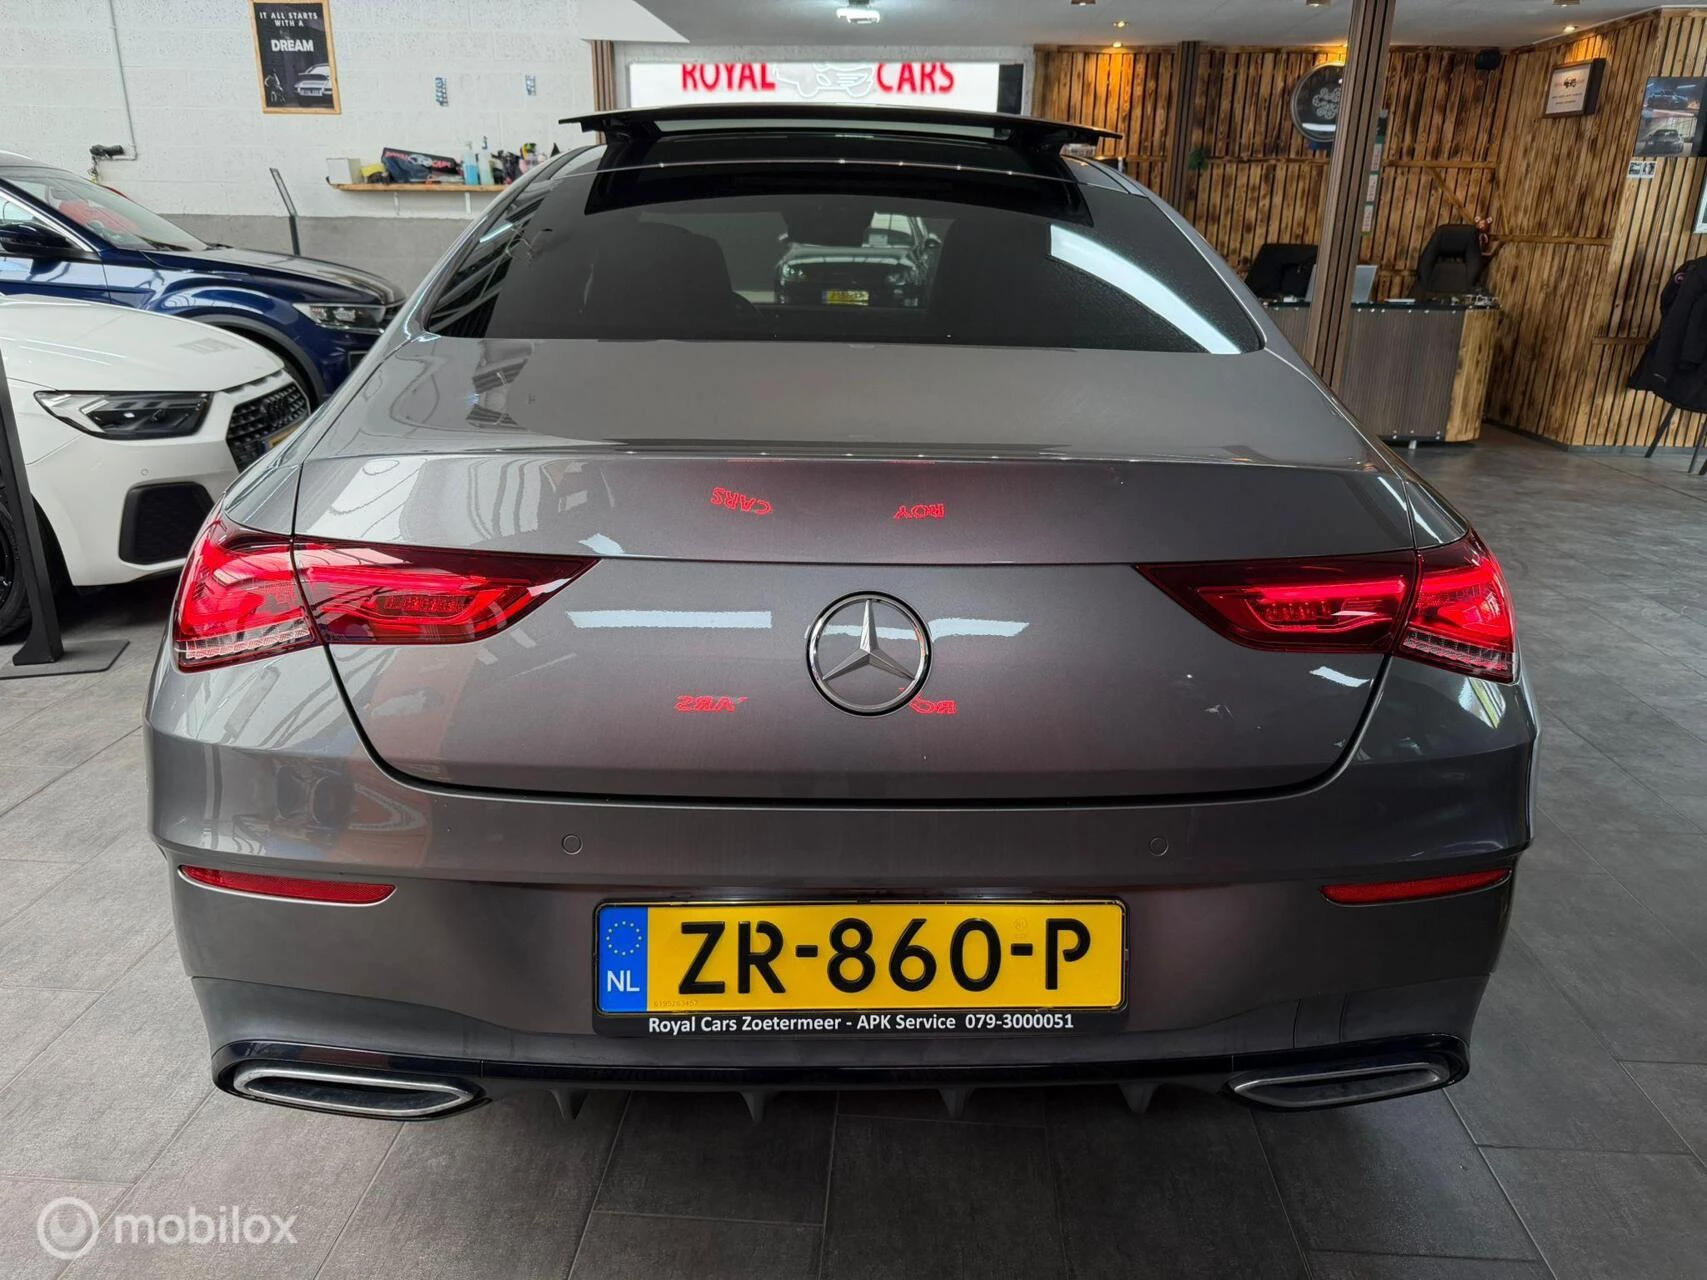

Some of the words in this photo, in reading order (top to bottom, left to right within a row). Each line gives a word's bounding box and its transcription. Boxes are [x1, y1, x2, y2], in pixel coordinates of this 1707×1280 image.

[260, 11, 267, 19] IT
[271, 11, 285, 19] ALL
[288, 11, 318, 20] STARTS
[274, 19, 295, 27] WITH
[298, 19, 304, 27] A
[271, 39, 314, 52] DREAM
[682, 62, 776, 91] ROYAL
[876, 62, 955, 93] CARS
[677, 917, 1091, 995] ZR-860-P
[607, 970, 640, 992] NL
[648, 1016, 696, 1035] Royal
[700, 1017, 737, 1032] Cars
[741, 1016, 841, 1031] Zoetermeer
[856, 1015, 891, 1029] APK
[895, 1014, 956, 1029] Service
[965, 1014, 1074, 1029] 079-3000051
